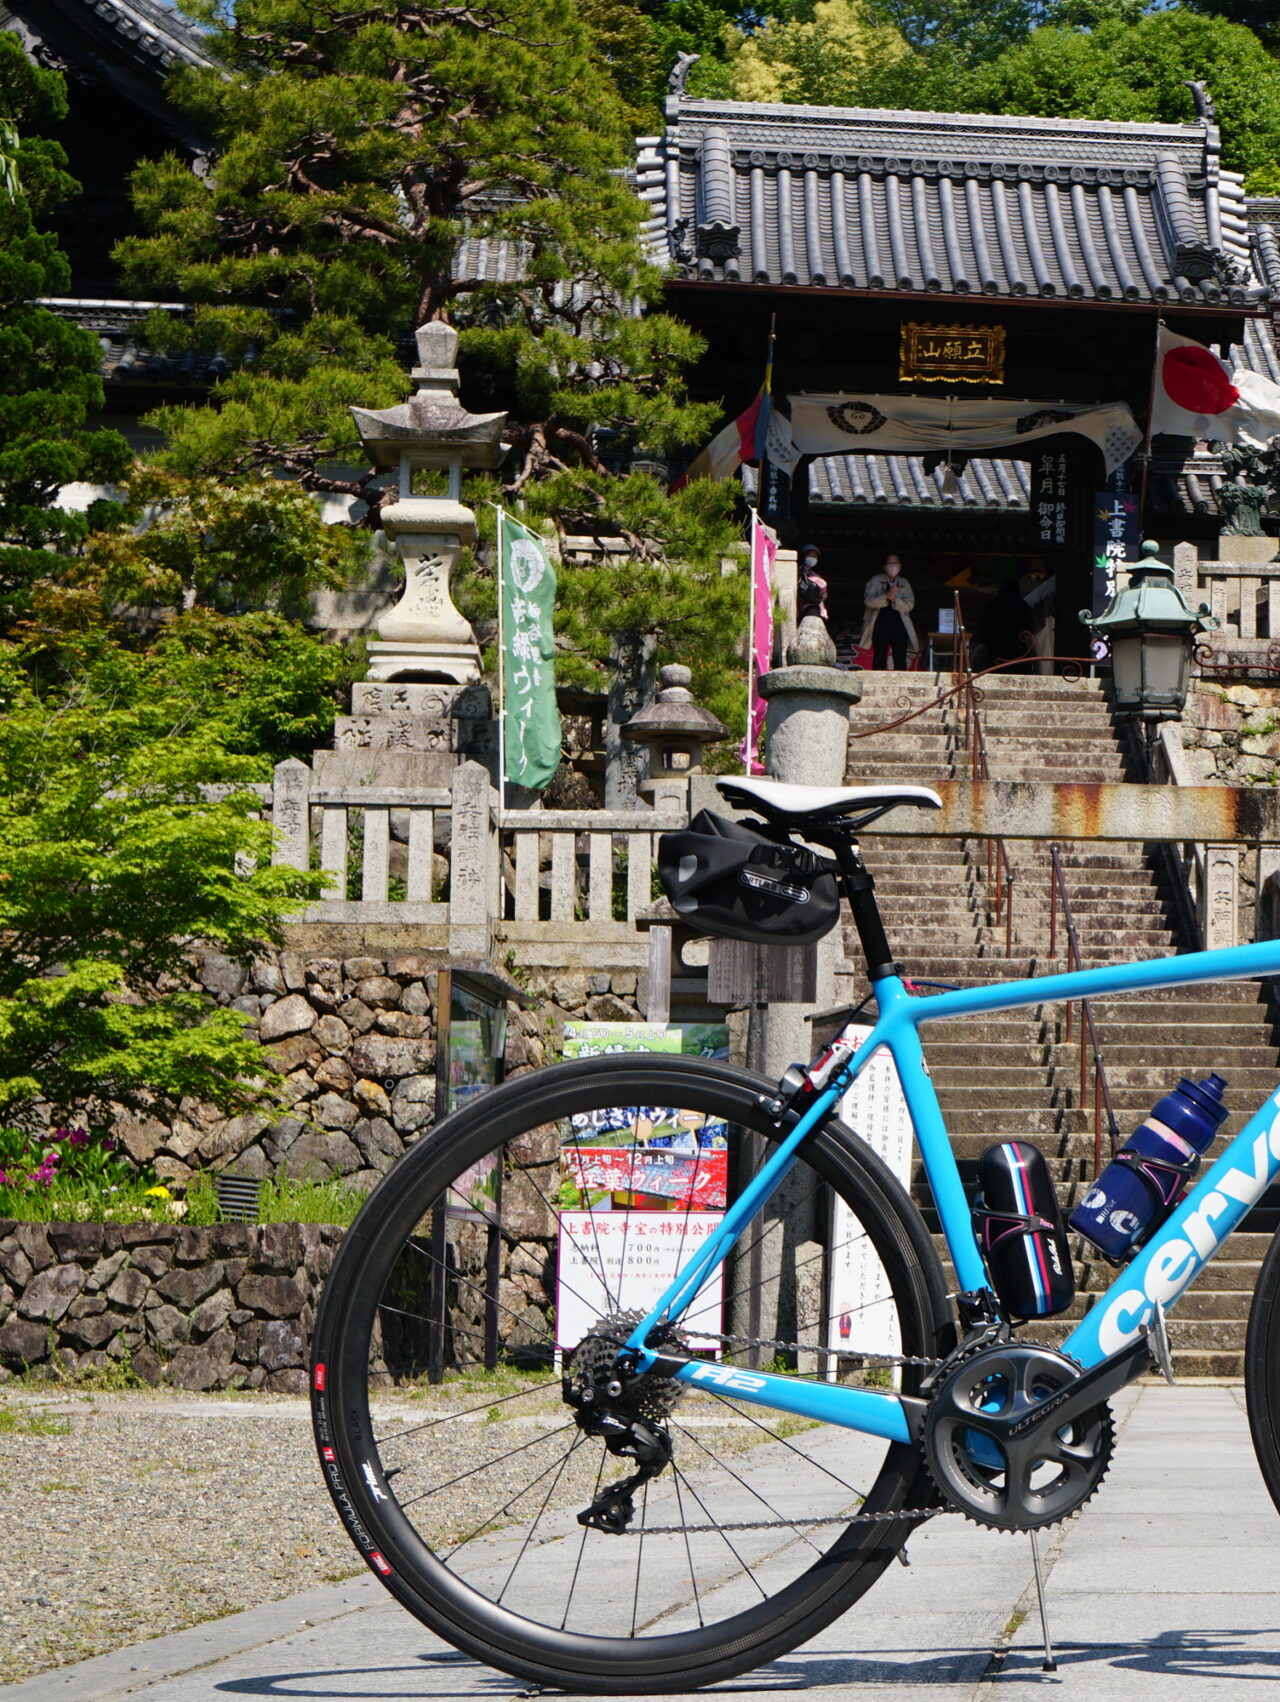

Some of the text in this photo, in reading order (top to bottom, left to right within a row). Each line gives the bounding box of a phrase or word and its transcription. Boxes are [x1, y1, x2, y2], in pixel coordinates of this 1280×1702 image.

[575, 1168, 712, 1192] 紅葉ウィーク
[1008, 1392, 1071, 1437] ULTEGRA
[338, 1493, 376, 1551] FORMULA
